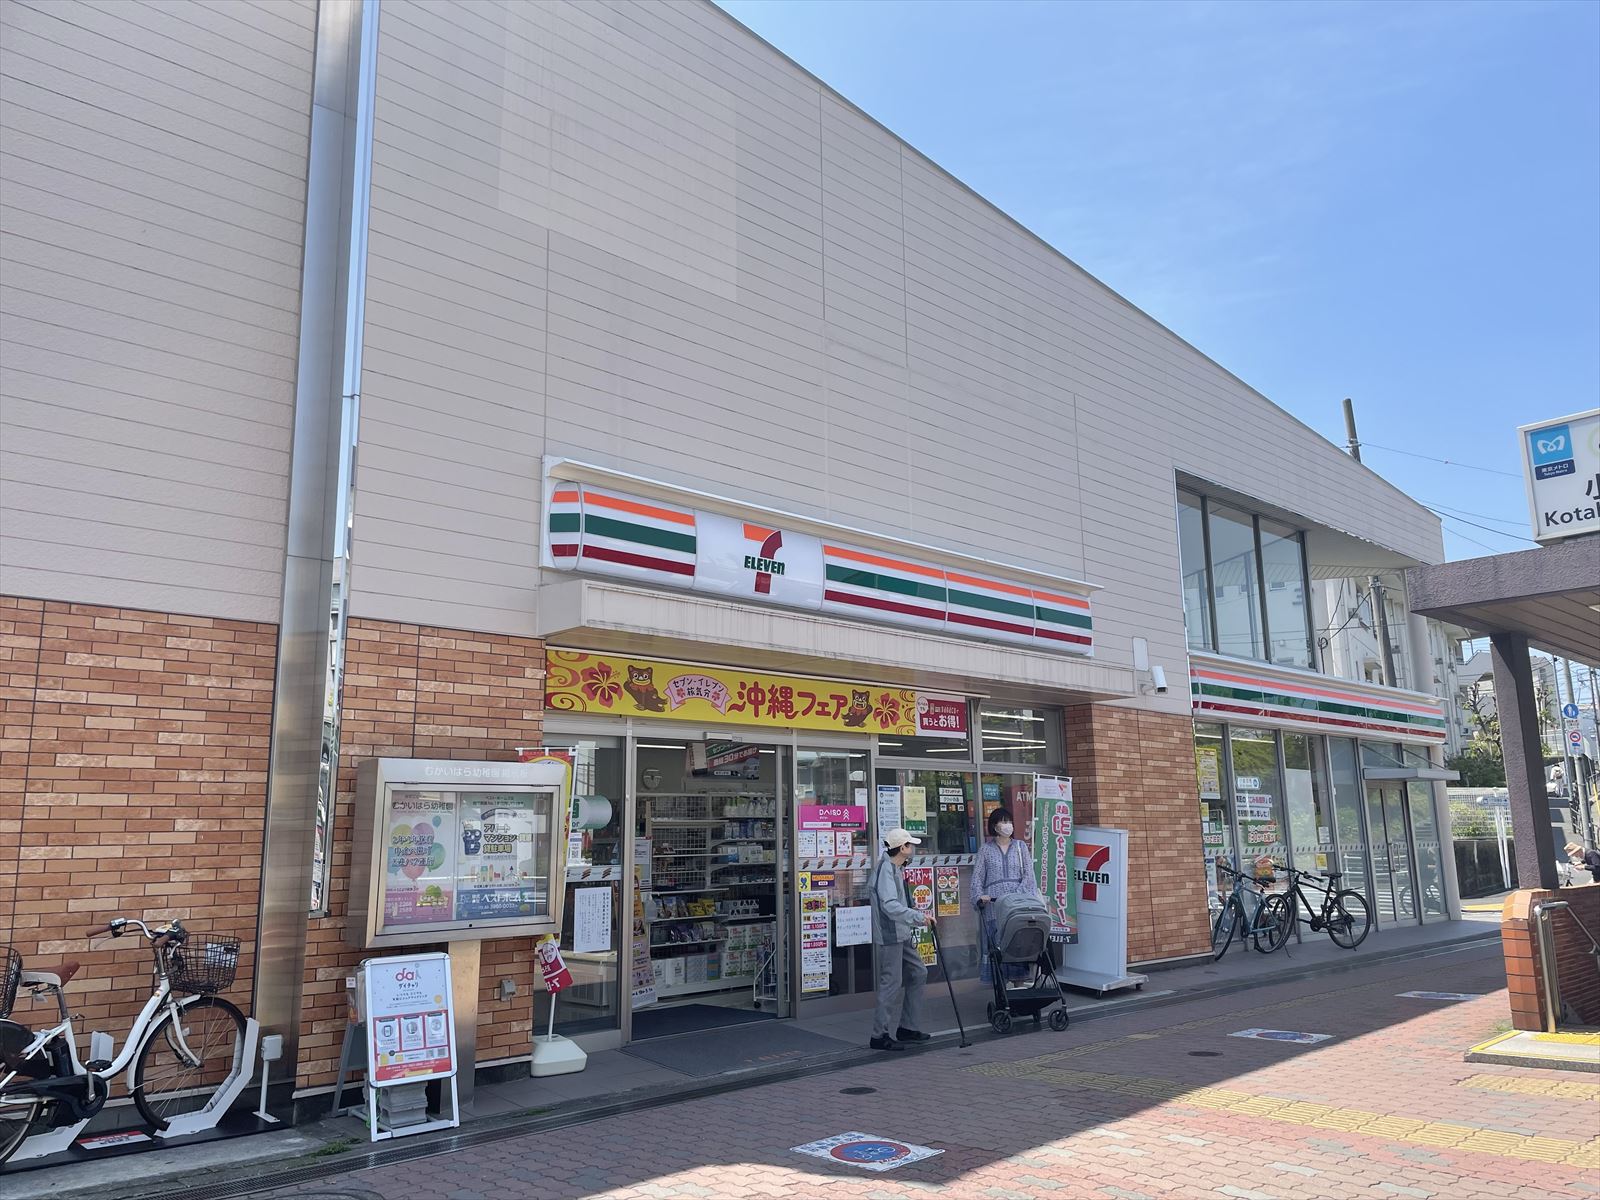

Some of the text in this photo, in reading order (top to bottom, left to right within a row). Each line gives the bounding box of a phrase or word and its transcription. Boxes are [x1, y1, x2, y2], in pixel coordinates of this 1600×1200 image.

[1541, 463, 1569, 473] 東京メトロ
[1544, 501, 1600, 527] Kota
[727, 680, 849, 721] 沖縄フェア
